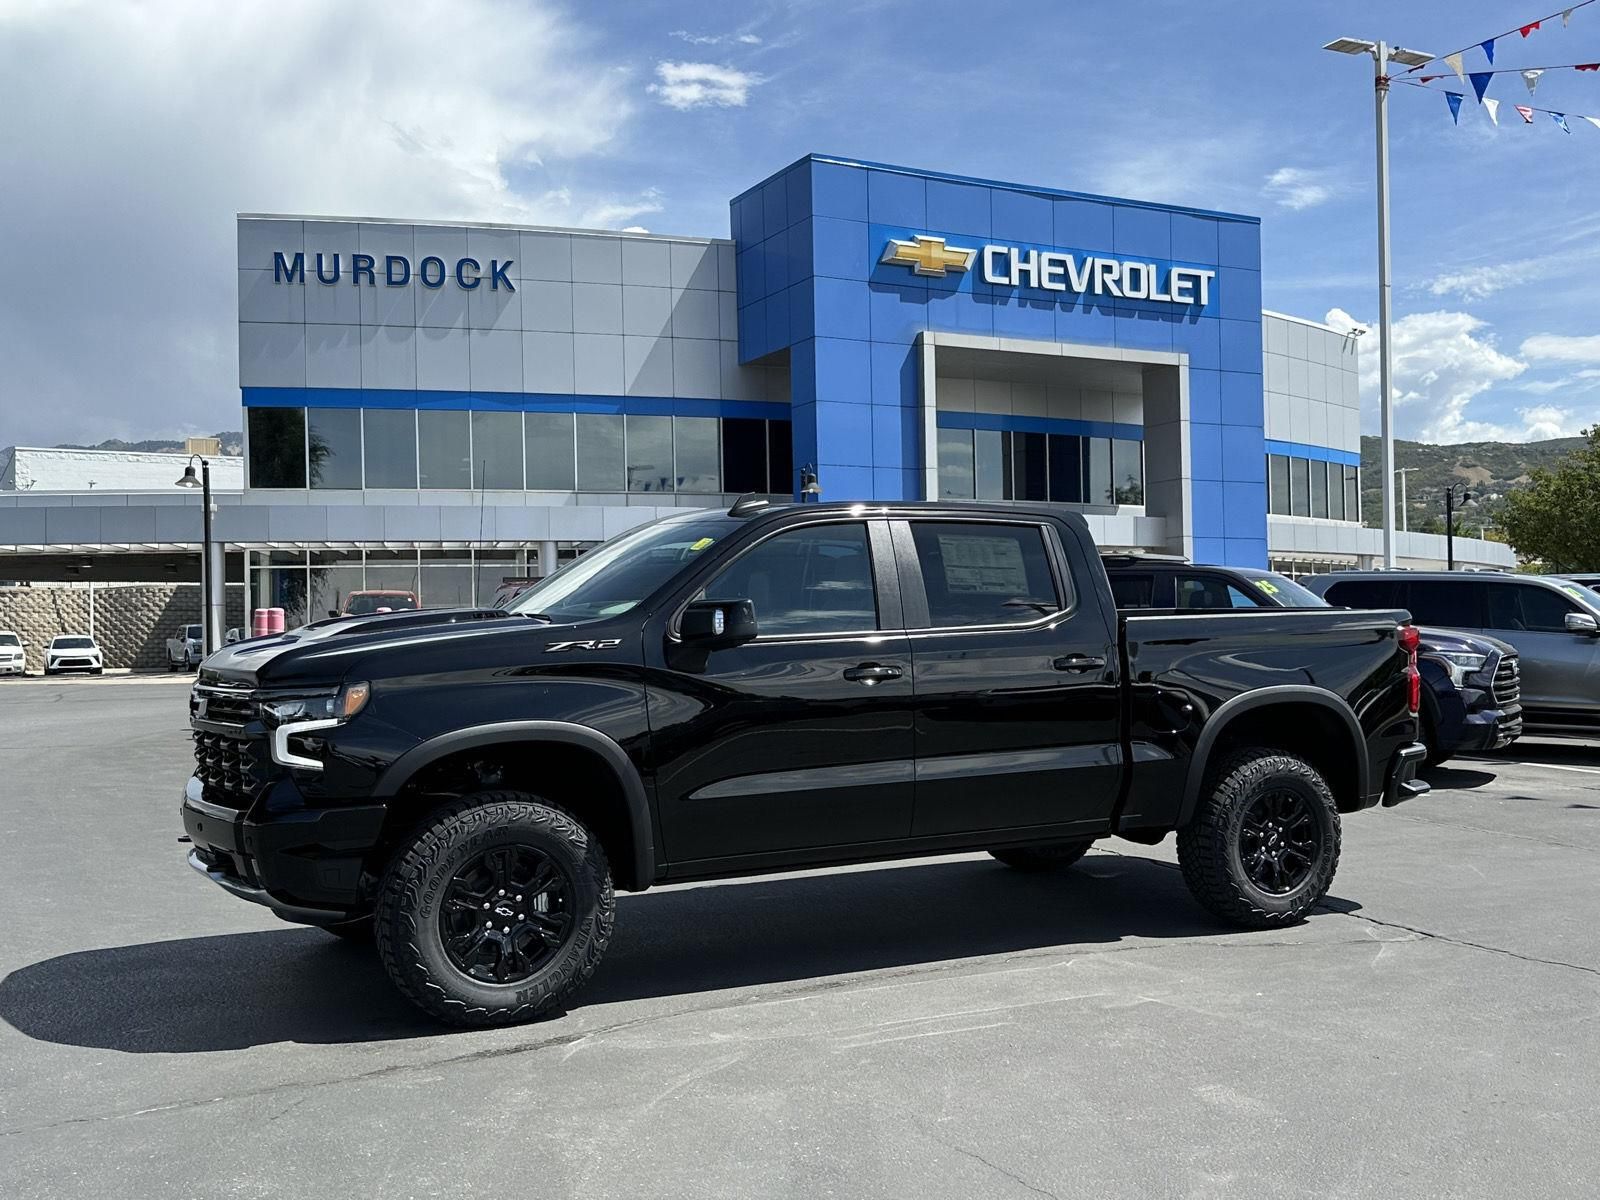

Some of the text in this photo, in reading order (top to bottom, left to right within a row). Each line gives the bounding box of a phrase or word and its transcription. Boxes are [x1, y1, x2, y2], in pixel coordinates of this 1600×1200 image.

[273, 251, 517, 293] MURDOCK
[983, 244, 1216, 306] CHEVROLET
[545, 638, 623, 653] ZR2
[515, 917, 595, 1004] WRANGLER
